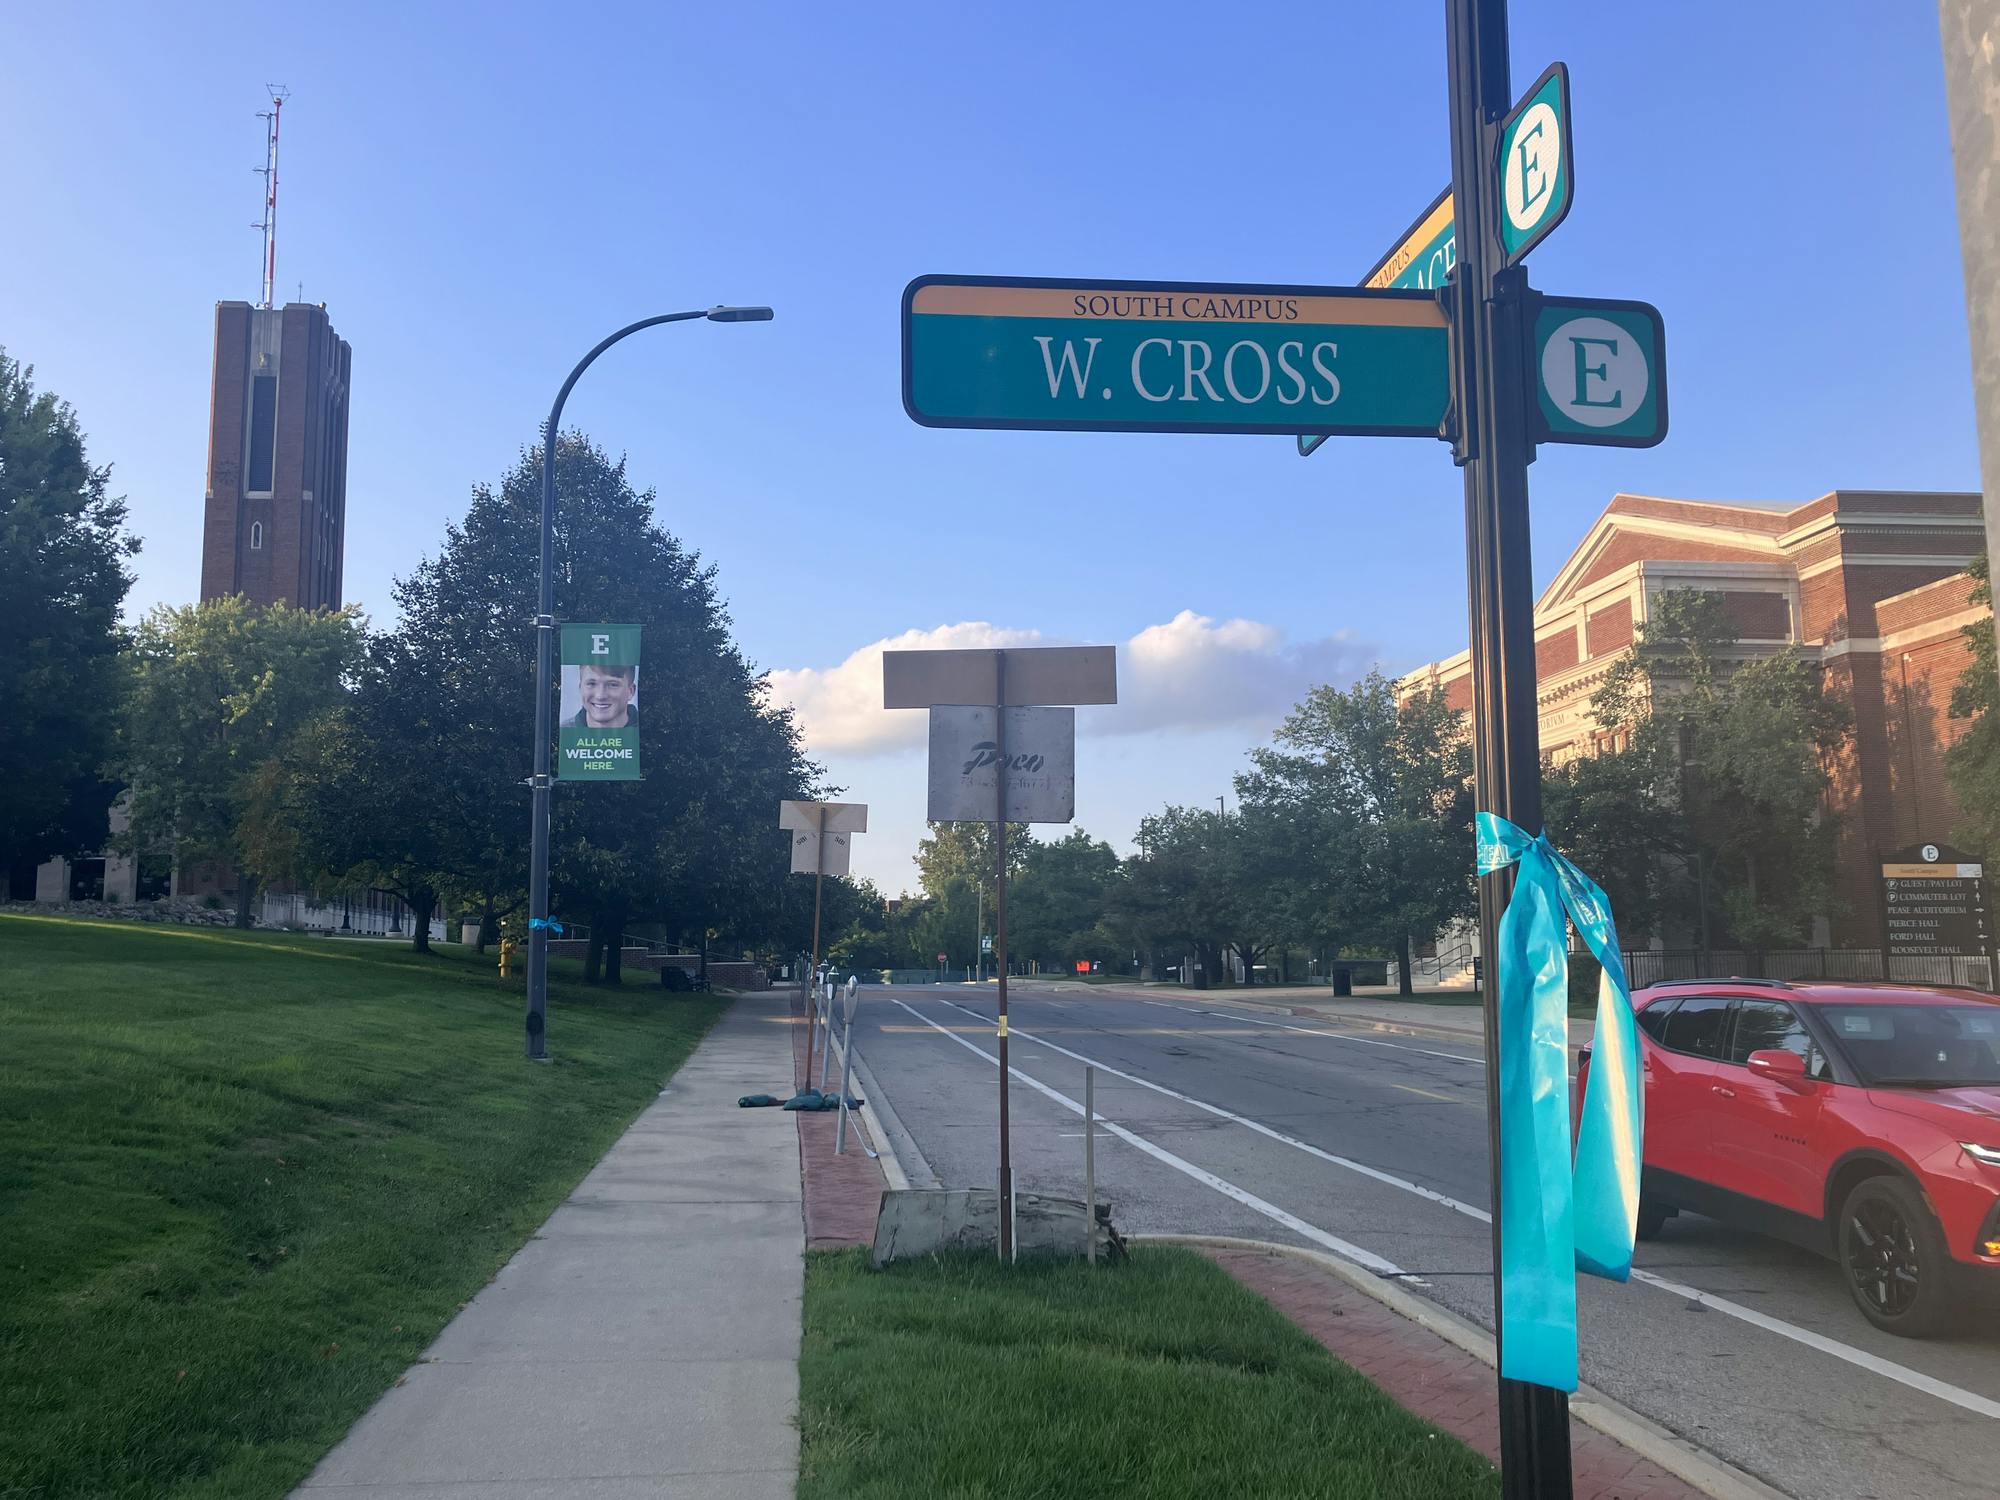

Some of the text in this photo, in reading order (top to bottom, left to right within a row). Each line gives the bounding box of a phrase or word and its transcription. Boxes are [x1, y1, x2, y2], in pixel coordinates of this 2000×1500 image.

[1518, 118, 1547, 215] E
[1073, 295, 1299, 320] SOUTH CAMPUS
[1033, 336, 1341, 405] W. CROSS
[1568, 336, 1622, 409] E
[591, 634, 610, 655] E
[576, 738, 622, 747] ALL ARE
[565, 749, 633, 759] WELCOME
[583, 761, 615, 770] HERE.
[1480, 844, 1514, 864] TEAL
[1927, 847, 1936, 860] E
[1899, 893, 1948, 901] COMMUTER
[1950, 893, 1967, 901] LOT
[1887, 906, 1967, 914] PEASE AUDITORIUM
[1920, 920, 1940, 928] HALL
[1890, 932, 1937, 941] FORD HALL
[1891, 946, 1962, 954] ROOSEVELT HALL
